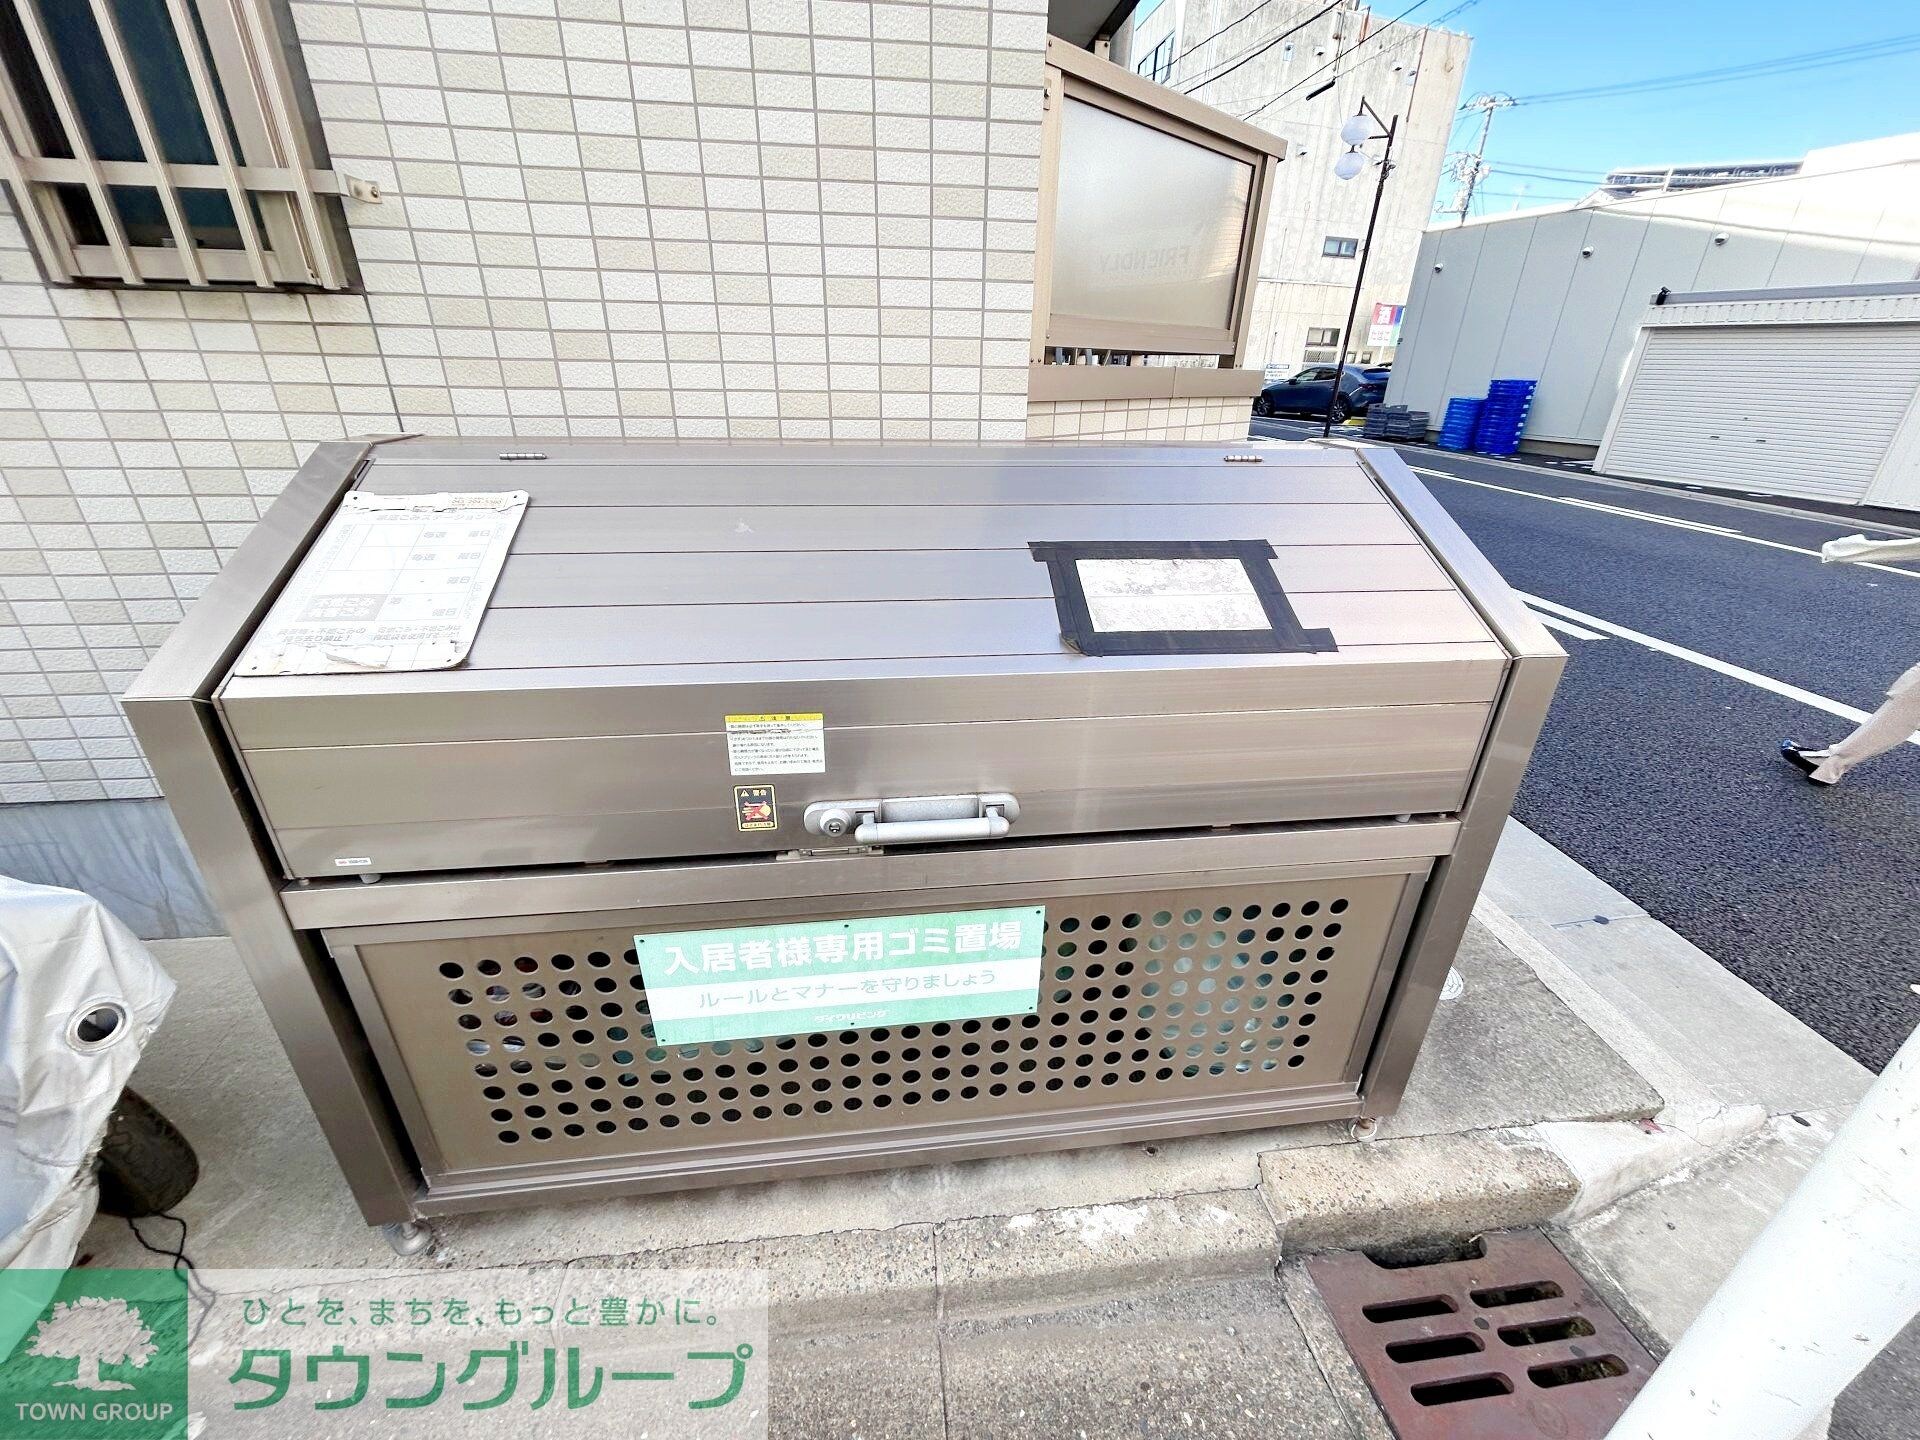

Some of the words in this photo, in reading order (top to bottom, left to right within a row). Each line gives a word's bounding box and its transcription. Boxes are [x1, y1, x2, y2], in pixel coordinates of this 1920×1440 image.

[665, 921, 1022, 976] 入居者様専用ゴミ置場
[698, 969, 997, 1009] ルールとマナーを守りましょう
